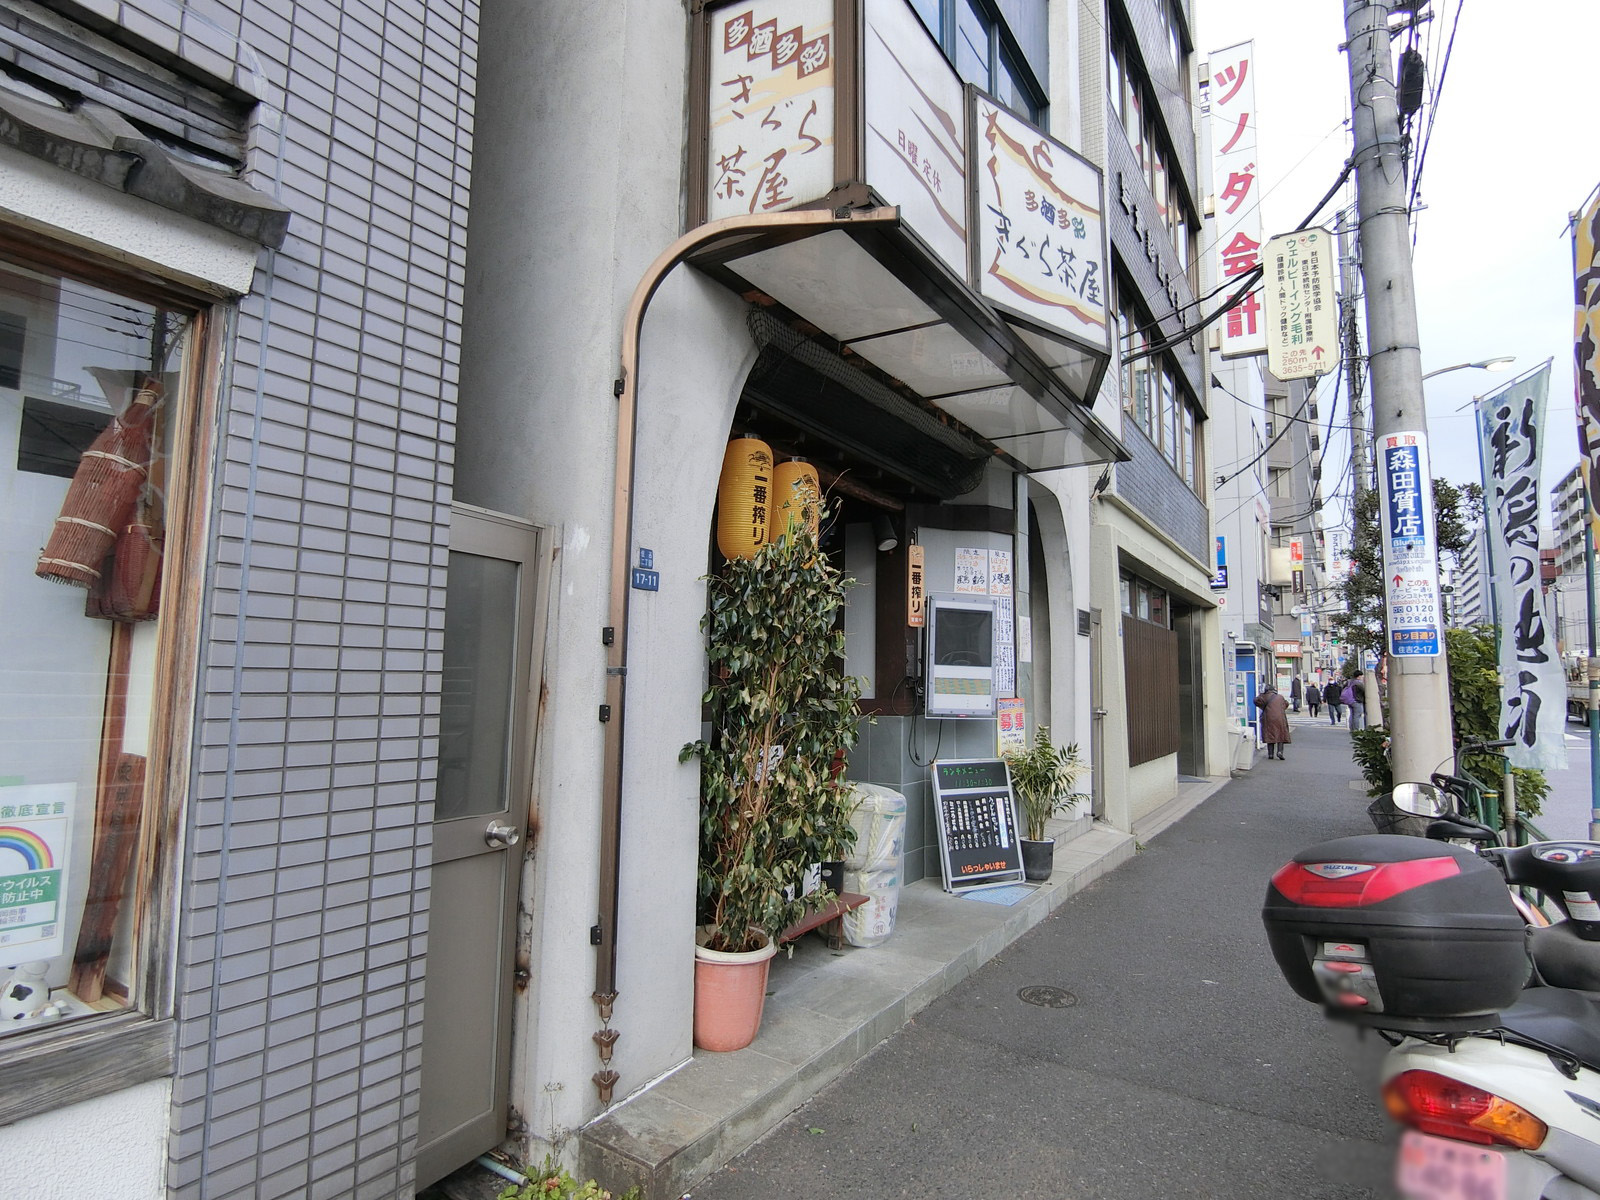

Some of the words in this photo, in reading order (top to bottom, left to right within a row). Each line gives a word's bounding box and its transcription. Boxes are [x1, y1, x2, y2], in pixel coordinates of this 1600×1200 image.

[727, 17, 827, 75] 多酒多彩
[897, 128, 943, 194] 日曜定休
[1213, 59, 1261, 338] ツノダ会計
[1024, 189, 1087, 240] 多酒多彩
[1286, 239, 1303, 345] ウェルビーイング毛利
[1282, 361, 1327, 375] 3635-5711
[1386, 435, 1417, 447] 買取
[1389, 449, 1421, 537] 森田質店
[752, 475, 768, 545] 一番搾り
[635, 572, 657, 586] 17-11
[1407, 579, 1431, 587] この先
[912, 564, 922, 613] 一番搾り
[1406, 605, 1434, 613] 0120
[1393, 615, 1434, 624] 782840
[1, 801, 66, 818] 徹底宣言
[961, 860, 1007, 874] いらっしゃいませ
[0, 875, 52, 891] ウイルス
